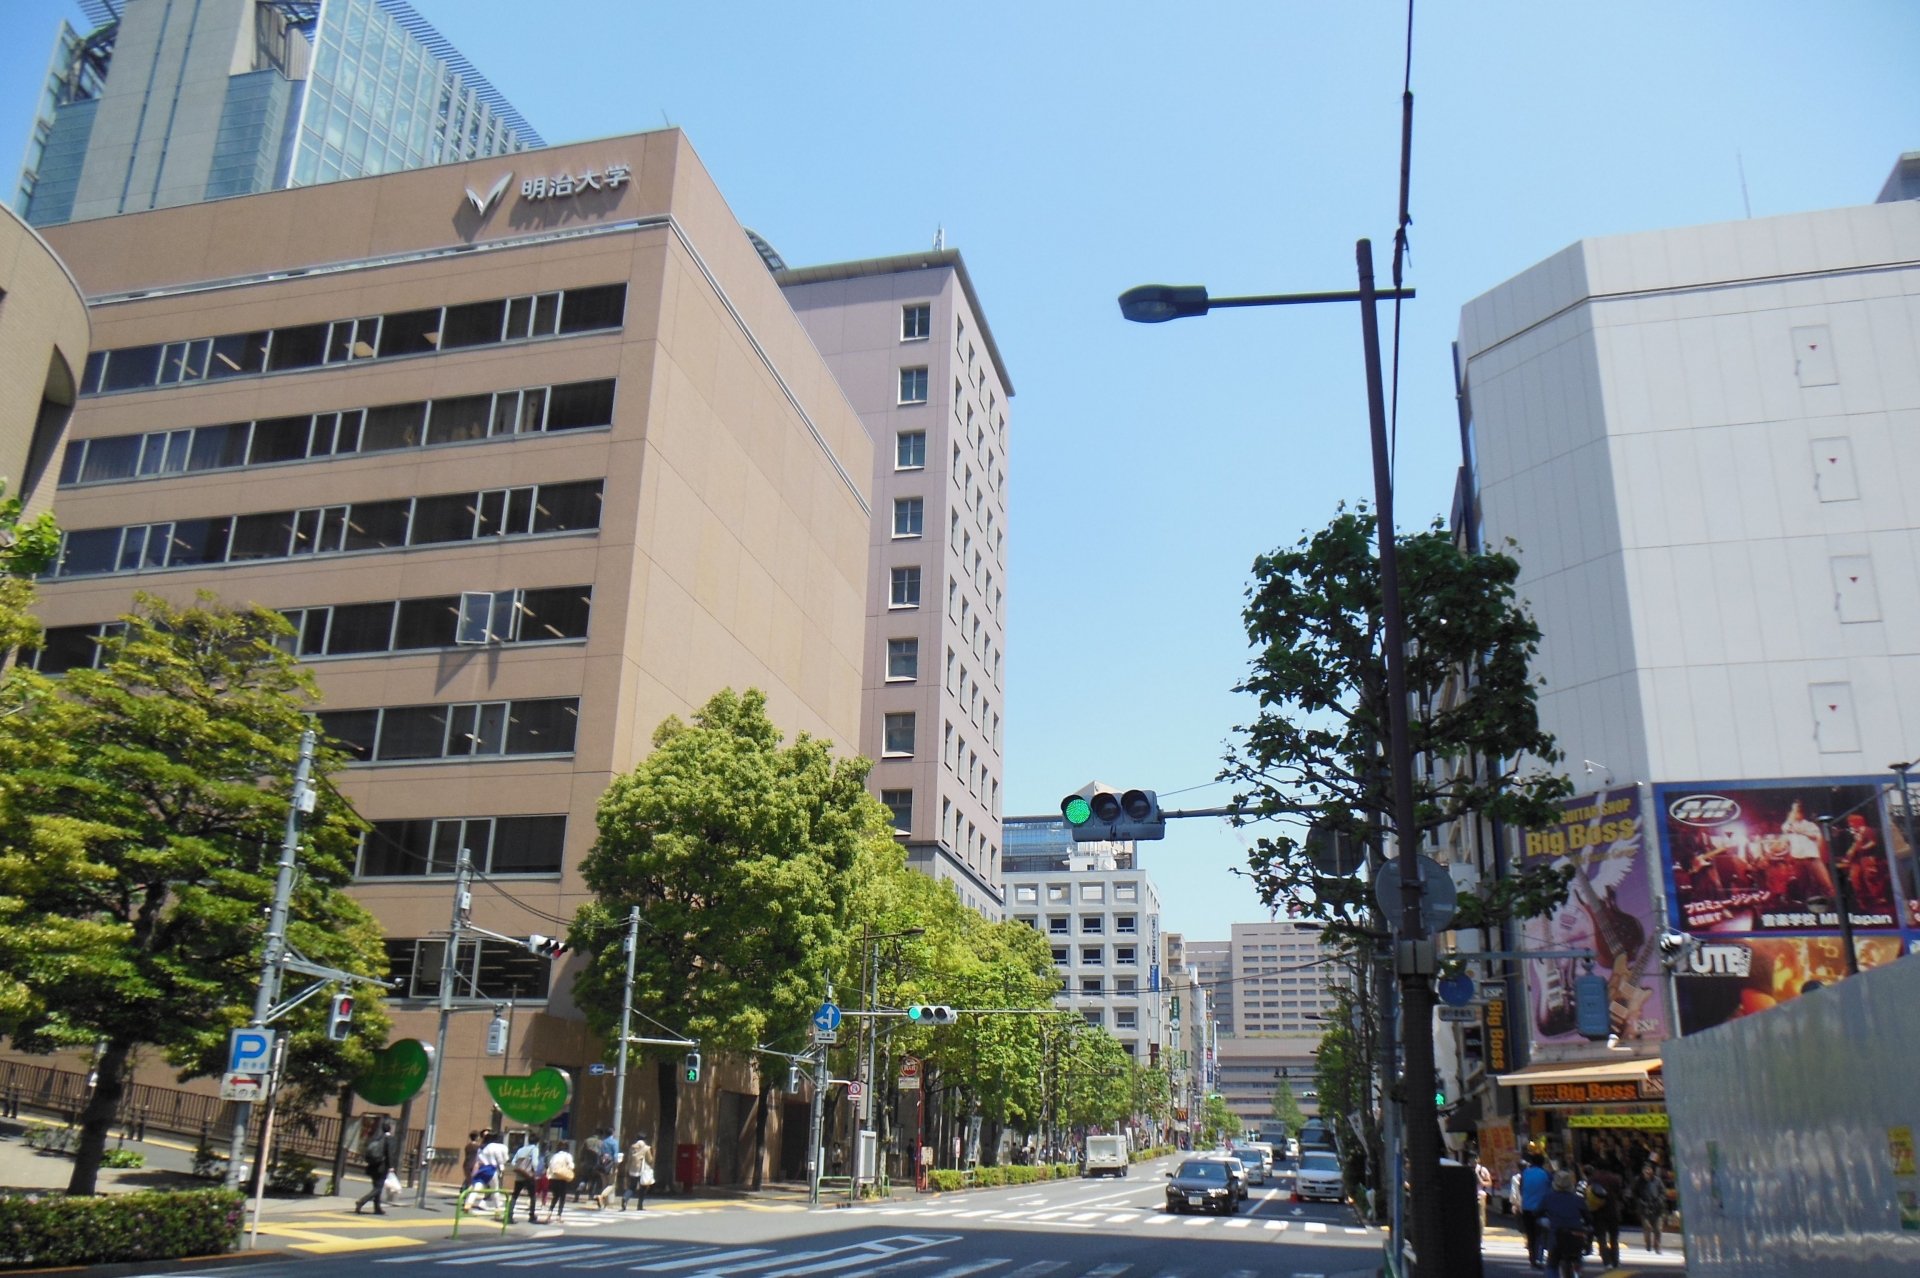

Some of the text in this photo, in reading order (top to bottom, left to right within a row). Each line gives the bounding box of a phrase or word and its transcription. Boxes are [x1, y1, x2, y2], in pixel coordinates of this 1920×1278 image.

[520, 164, 631, 200] 明治大学
[1525, 830, 1565, 857] Big
[1568, 818, 1636, 849] Boss
[1683, 890, 1771, 914] プロミュージシャン
[232, 1034, 267, 1069] P
[1486, 1000, 1505, 1070] Big Boss
[499, 1080, 561, 1101] 山の上ホテル
[1557, 1083, 1586, 1102] Big
[1588, 1082, 1636, 1100] Boss
